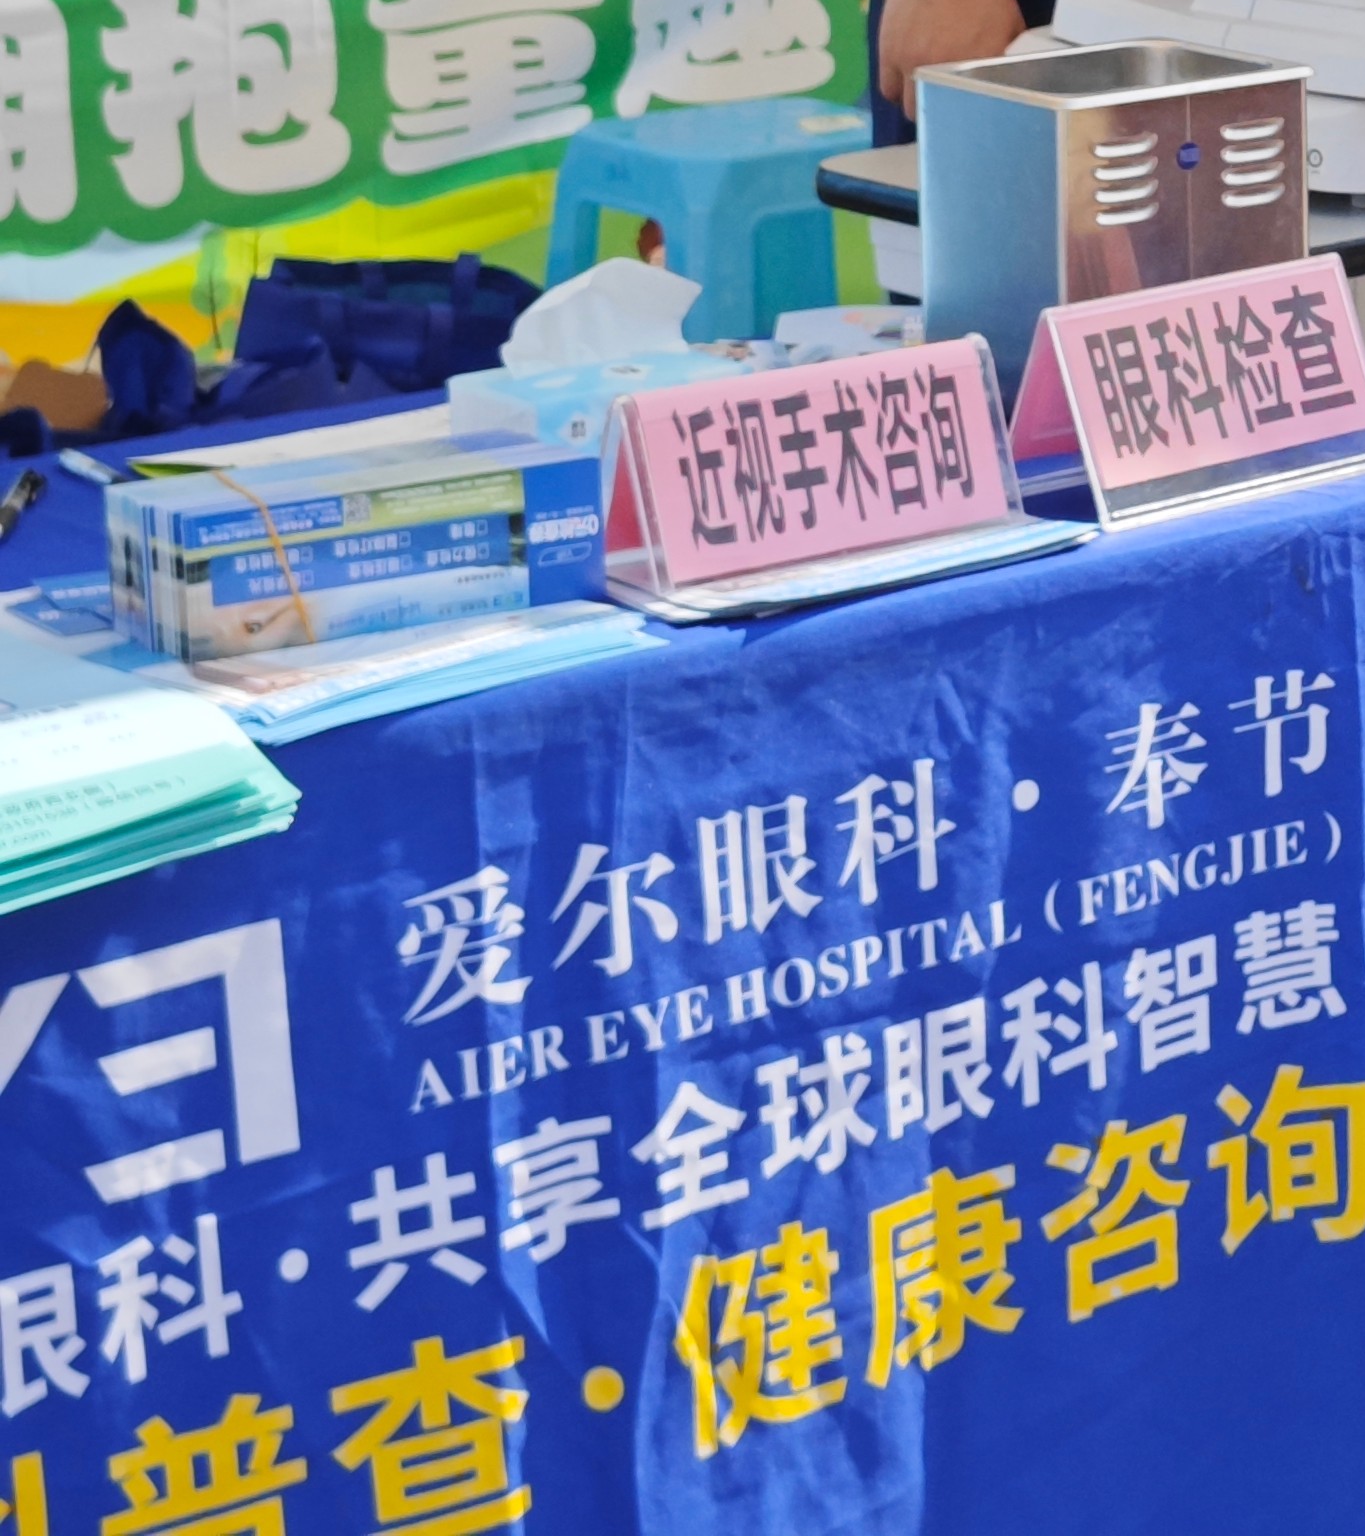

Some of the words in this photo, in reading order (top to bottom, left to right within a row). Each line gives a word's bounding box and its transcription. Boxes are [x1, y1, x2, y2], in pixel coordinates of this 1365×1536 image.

[671, 363, 976, 550] 近视手术咨询
[1084, 284, 1355, 460] 眼科检查
[410, 1025, 569, 1114] AIER
[585, 984, 715, 1064] EYE
[726, 900, 1023, 1026] HOSPITAL
